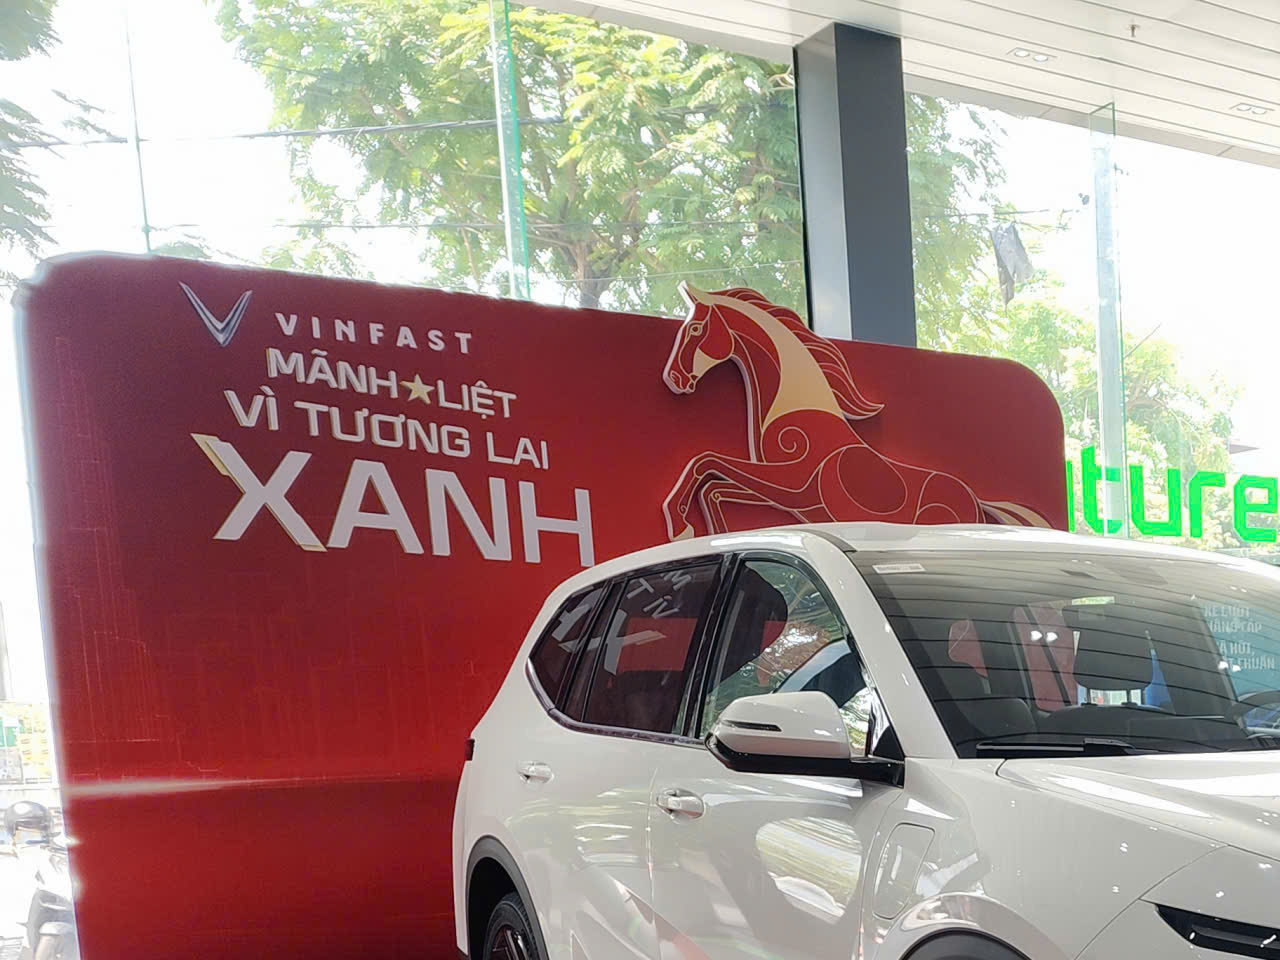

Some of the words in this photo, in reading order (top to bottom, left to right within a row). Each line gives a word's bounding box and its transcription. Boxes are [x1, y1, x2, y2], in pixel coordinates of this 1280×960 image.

[275, 313, 472, 354] VINFAST
[266, 348, 399, 399] MÃNH
[436, 380, 517, 420] LIỆT
[223, 386, 280, 431] VÌ
[294, 401, 470, 458] TƯƠNG
[486, 431, 549, 470] LAI
[190, 433, 596, 568] XANH
[1066, 446, 1279, 543] ture
